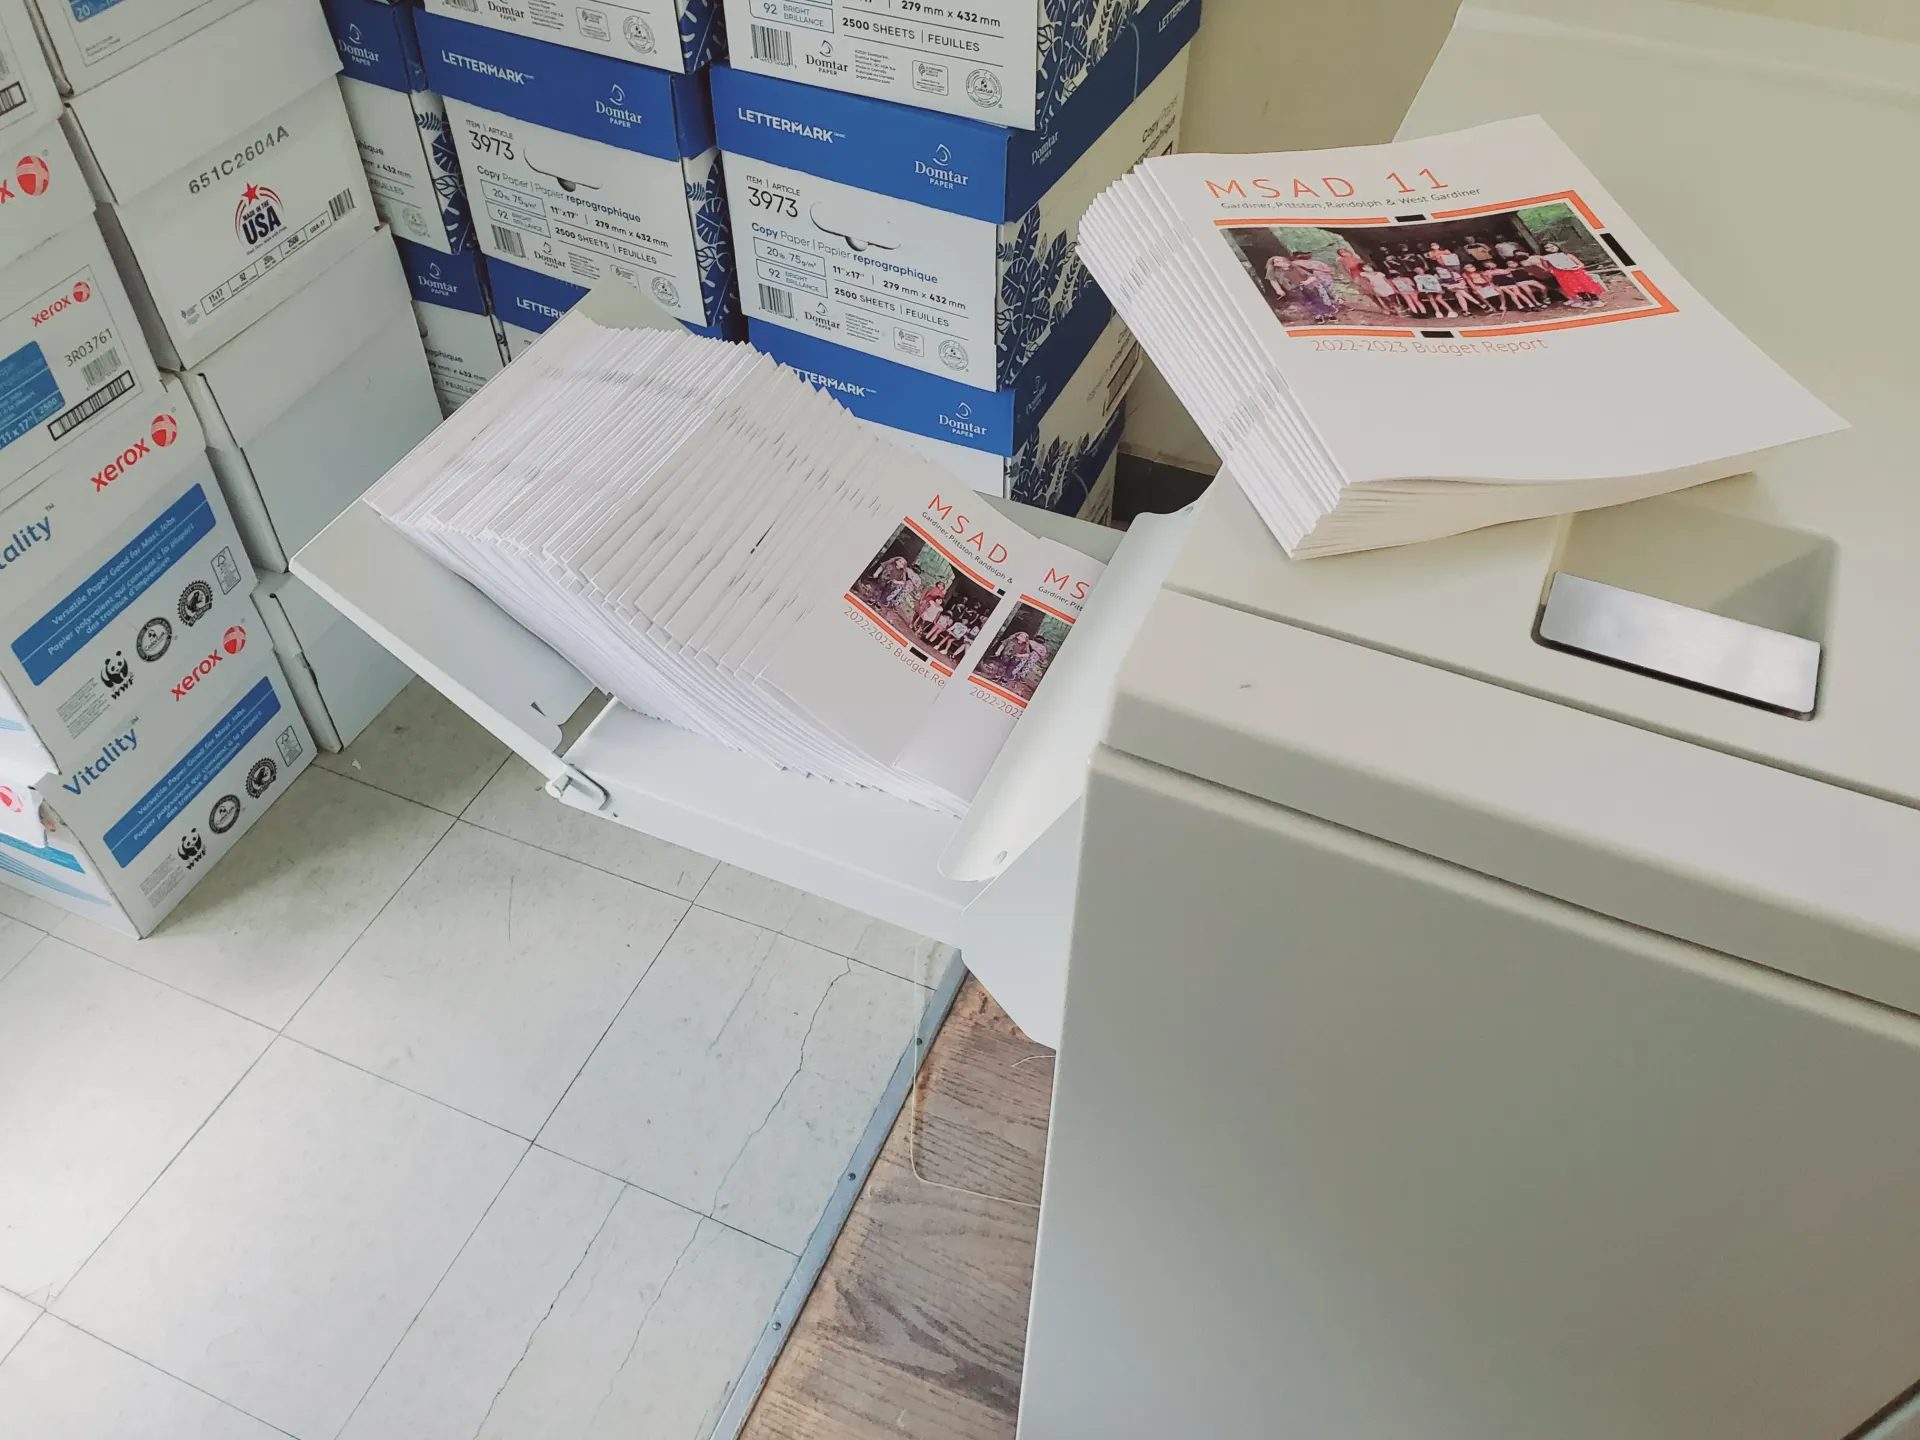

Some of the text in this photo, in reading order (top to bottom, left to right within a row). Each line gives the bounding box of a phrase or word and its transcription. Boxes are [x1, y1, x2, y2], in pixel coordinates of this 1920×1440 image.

[488, 1, 524, 19] Domtar
[499, 14, 517, 22] PAPER
[762, 3, 778, 15] 92
[782, 4, 810, 16] BRIGHT
[783, 12, 824, 27] BRILLANCE
[901, 0, 1001, 28] 279 mm x 432 mm
[842, 17, 981, 52] 2500 SHEETS FEUILLES
[338, 39, 380, 63] Domtar
[351, 56, 372, 67] PAPER
[805, 53, 849, 72] Domtar
[440, 49, 525, 85] LETTERMARK
[818, 67, 838, 76] PAPER
[595, 100, 643, 125] Domtar
[608, 117, 632, 129] PAPER
[737, 107, 834, 143] LETTERMARK
[465, 118, 514, 140] ITEM ARTICLE
[468, 130, 515, 161] 3973
[1031, 131, 1059, 166] Domtar
[188, 125, 289, 195] 651C2604A
[746, 174, 801, 197] ITEM ARTICLE
[914, 160, 970, 187] Domtar
[929, 177, 955, 190] PAPER
[1204, 167, 1449, 200] MSAD 11
[476, 165, 641, 223] Copy Paper Papier reprographique
[747, 185, 799, 218] 3973
[1326, 197, 1382, 210] Randolph
[1386, 198, 1396, 206] &
[1397, 194, 1429, 206] West
[1430, 187, 1481, 201] Gardiner
[241, 204, 282, 245] USA
[496, 208, 509, 220] 92
[554, 226, 576, 240] 2500
[577, 232, 610, 250] SHEETS
[617, 245, 658, 266] FEUILLES
[594, 219, 610, 231] 279
[610, 224, 628, 236] mm
[634, 231, 652, 244] 432
[652, 237, 669, 249] mm
[533, 250, 567, 269] Domtar
[751, 221, 939, 285] Copy Paper Papier reprographique
[417, 275, 459, 294] Domtar
[768, 267, 781, 279] 92
[784, 271, 809, 283] BRIGHT
[785, 278, 820, 293] BRILLANCE
[834, 287, 950, 328] 2500 SHEETS FEUILLES
[883, 279, 900, 292] 279
[900, 286, 919, 298] mm
[928, 294, 948, 305] 432
[948, 299, 967, 311] mm
[31, 294, 72, 328] xerox
[804, 311, 841, 331] Domtar
[814, 322, 832, 332] PAPER
[64, 328, 113, 368] 3R03761
[1312, 337, 1549, 357] 2022-2023 Budget Report
[938, 413, 988, 436] Domtar
[951, 428, 975, 439] PAPER
[90, 437, 151, 493] xerox
[927, 494, 1009, 565] MSAD
[921, 511, 1014, 585] Gardiner, Pittston, Randolph &
[51, 515, 177, 626] Versatile Paper Good for Most Jobs
[47, 630, 75, 656] Papier
[74, 596, 115, 635] polyvalent
[114, 583, 127, 599] qui
[125, 558, 158, 590] convient
[1038, 585, 1070, 607] Gardiner,
[85, 618, 100, 636] des
[843, 605, 896, 652] 2022-2023
[893, 646, 931, 681] Budget
[110, 674, 135, 700] WWF
[170, 648, 224, 702] xerox
[62, 727, 138, 796] Vitality
[166, 768, 188, 788] Paper
[133, 817, 157, 842] Papier
[185, 848, 208, 871] WWF
